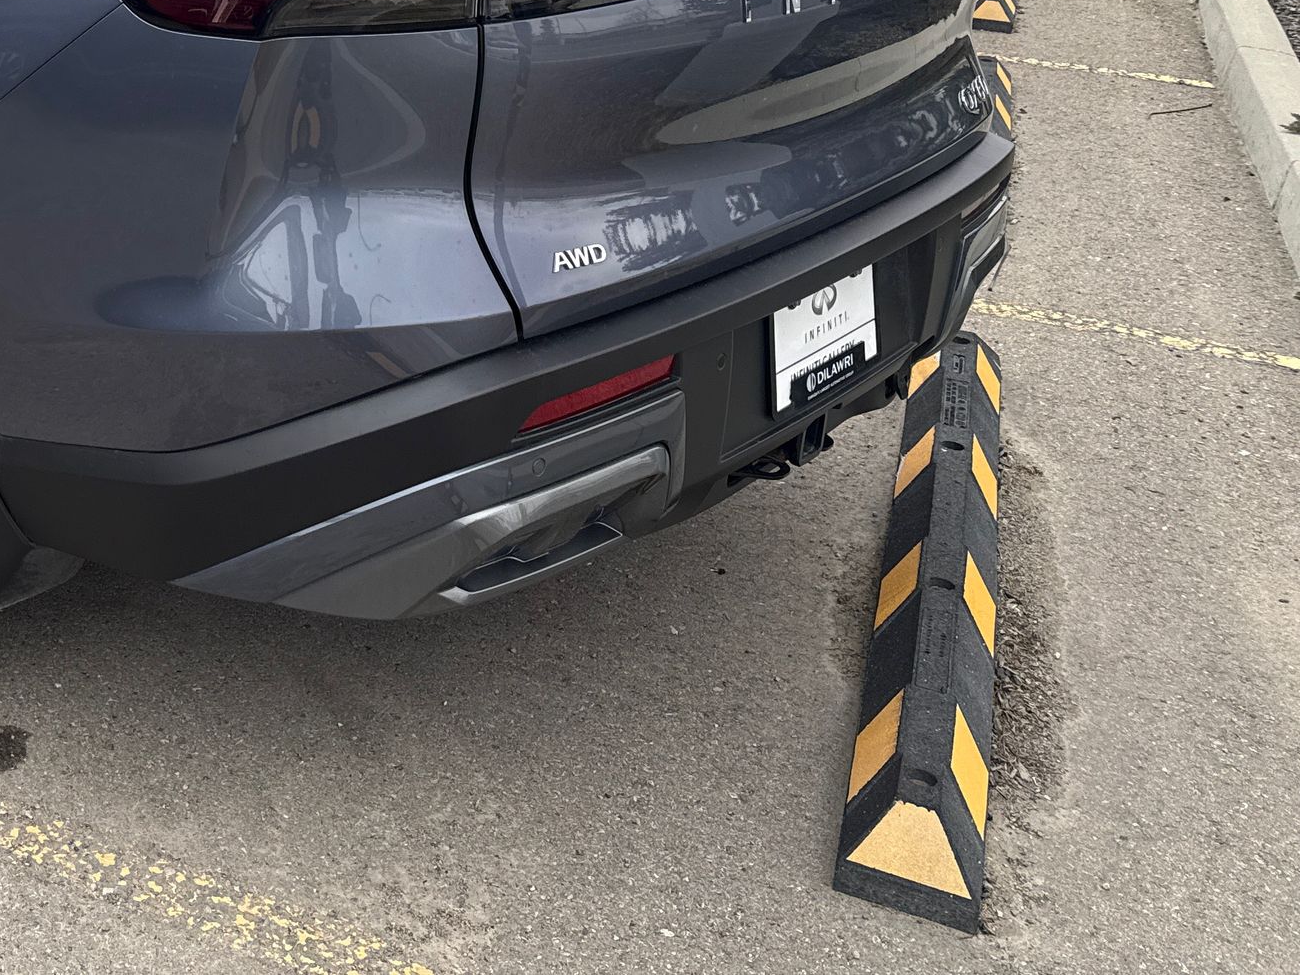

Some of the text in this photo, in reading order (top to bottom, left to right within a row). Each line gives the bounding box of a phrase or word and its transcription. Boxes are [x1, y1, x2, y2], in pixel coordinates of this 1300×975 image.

[552, 243, 607, 274] AWD
[804, 311, 849, 344] INFINITI
[816, 353, 854, 385] DILAWRI
